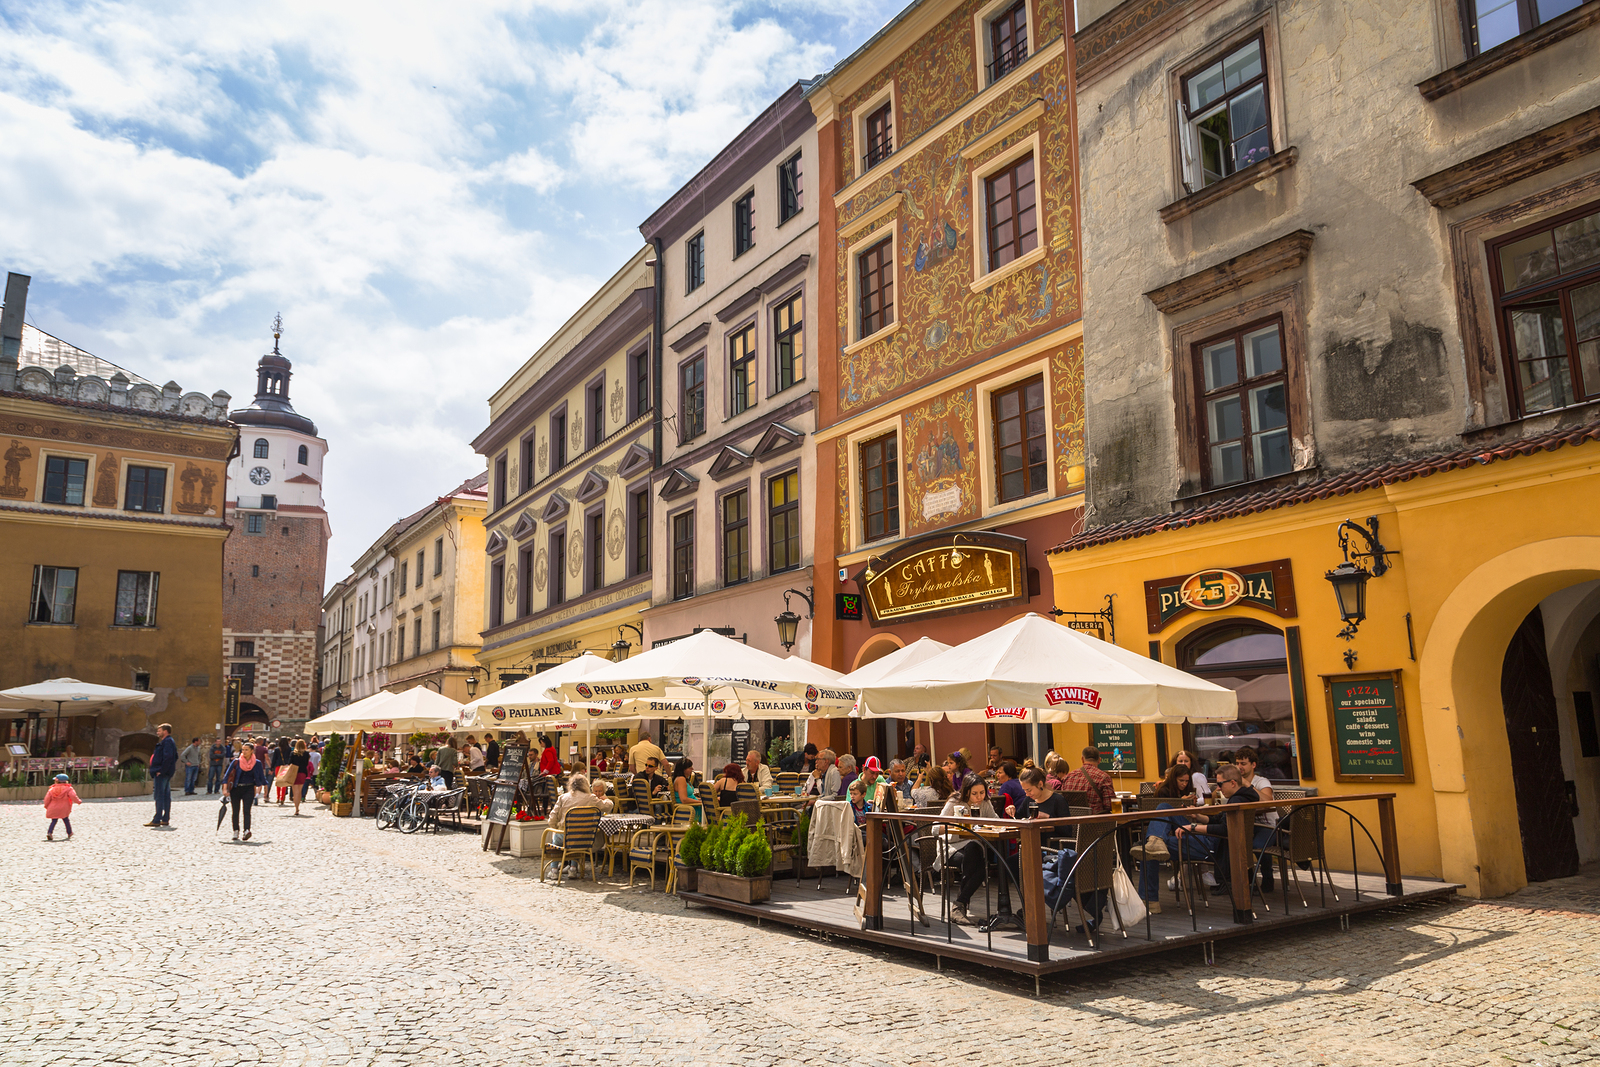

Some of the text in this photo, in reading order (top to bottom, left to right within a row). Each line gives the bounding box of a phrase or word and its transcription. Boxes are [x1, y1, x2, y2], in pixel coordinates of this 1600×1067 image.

[896, 569, 982, 600] Trybunalska
[1160, 578, 1272, 613] PIZZERIA
[593, 682, 654, 695] PAULANER
[819, 688, 856, 701] PAULANER
[1346, 686, 1380, 698] PIZZA
[1051, 688, 1095, 703] ŻYWIEC
[1354, 698, 1386, 706] speciality
[509, 706, 563, 718] PAULANER
